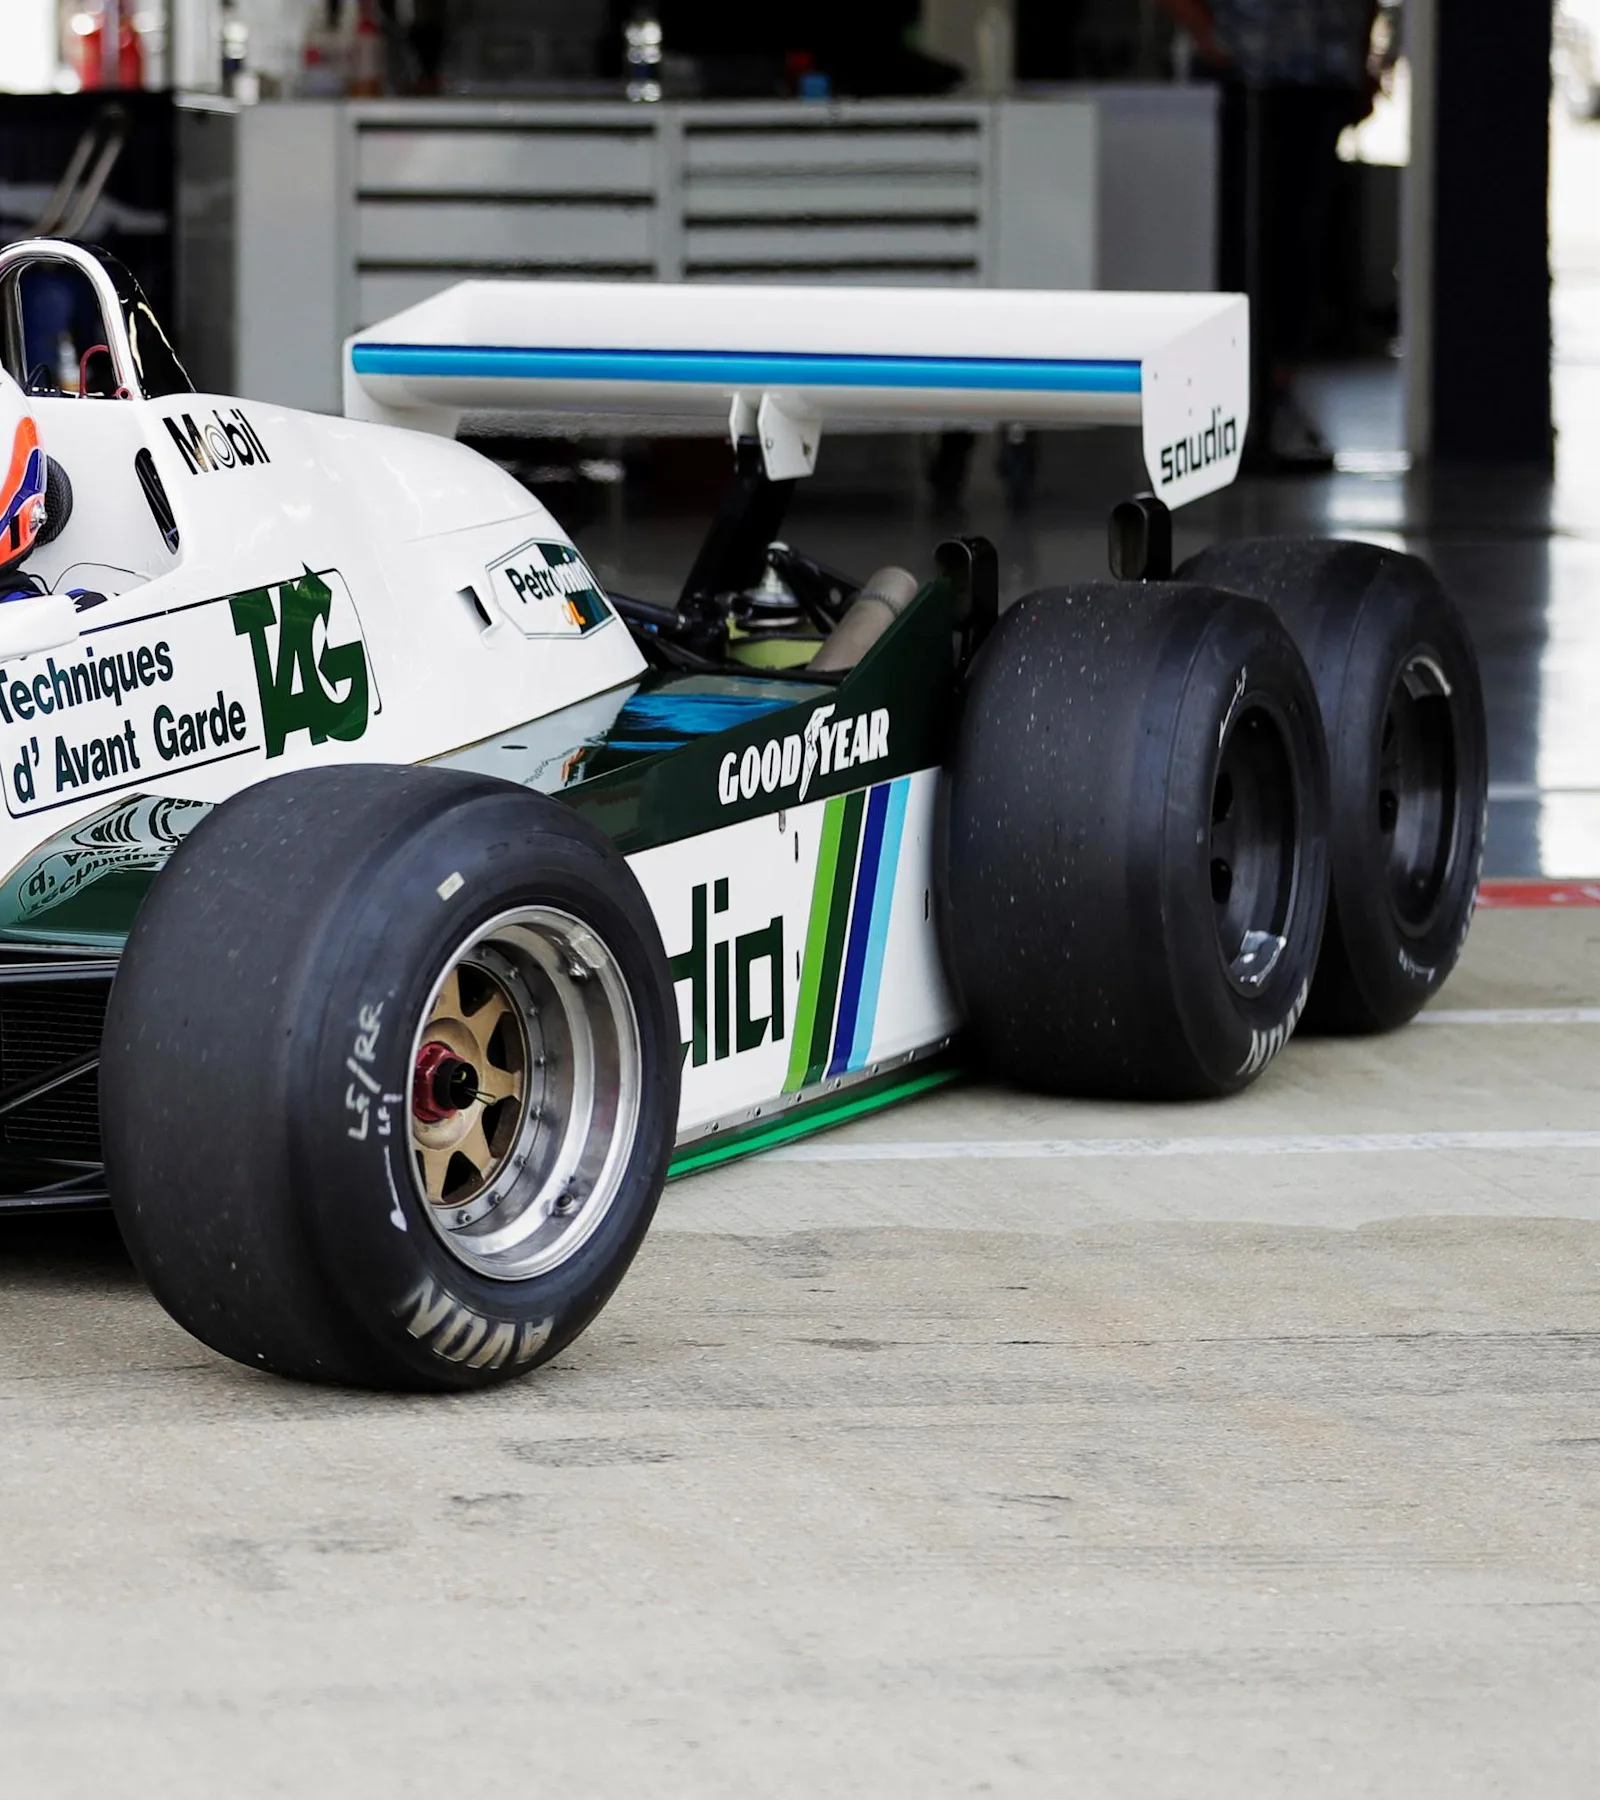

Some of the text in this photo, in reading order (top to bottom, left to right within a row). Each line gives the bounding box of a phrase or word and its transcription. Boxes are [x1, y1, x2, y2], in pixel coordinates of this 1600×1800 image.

[162, 409, 271, 475] Mobil
[1161, 405, 1236, 485] saudia
[229, 562, 370, 760] TAG
[55, 720, 141, 792] Avant
[153, 690, 246, 761] Garde
[392, 1274, 555, 1370] AVON
